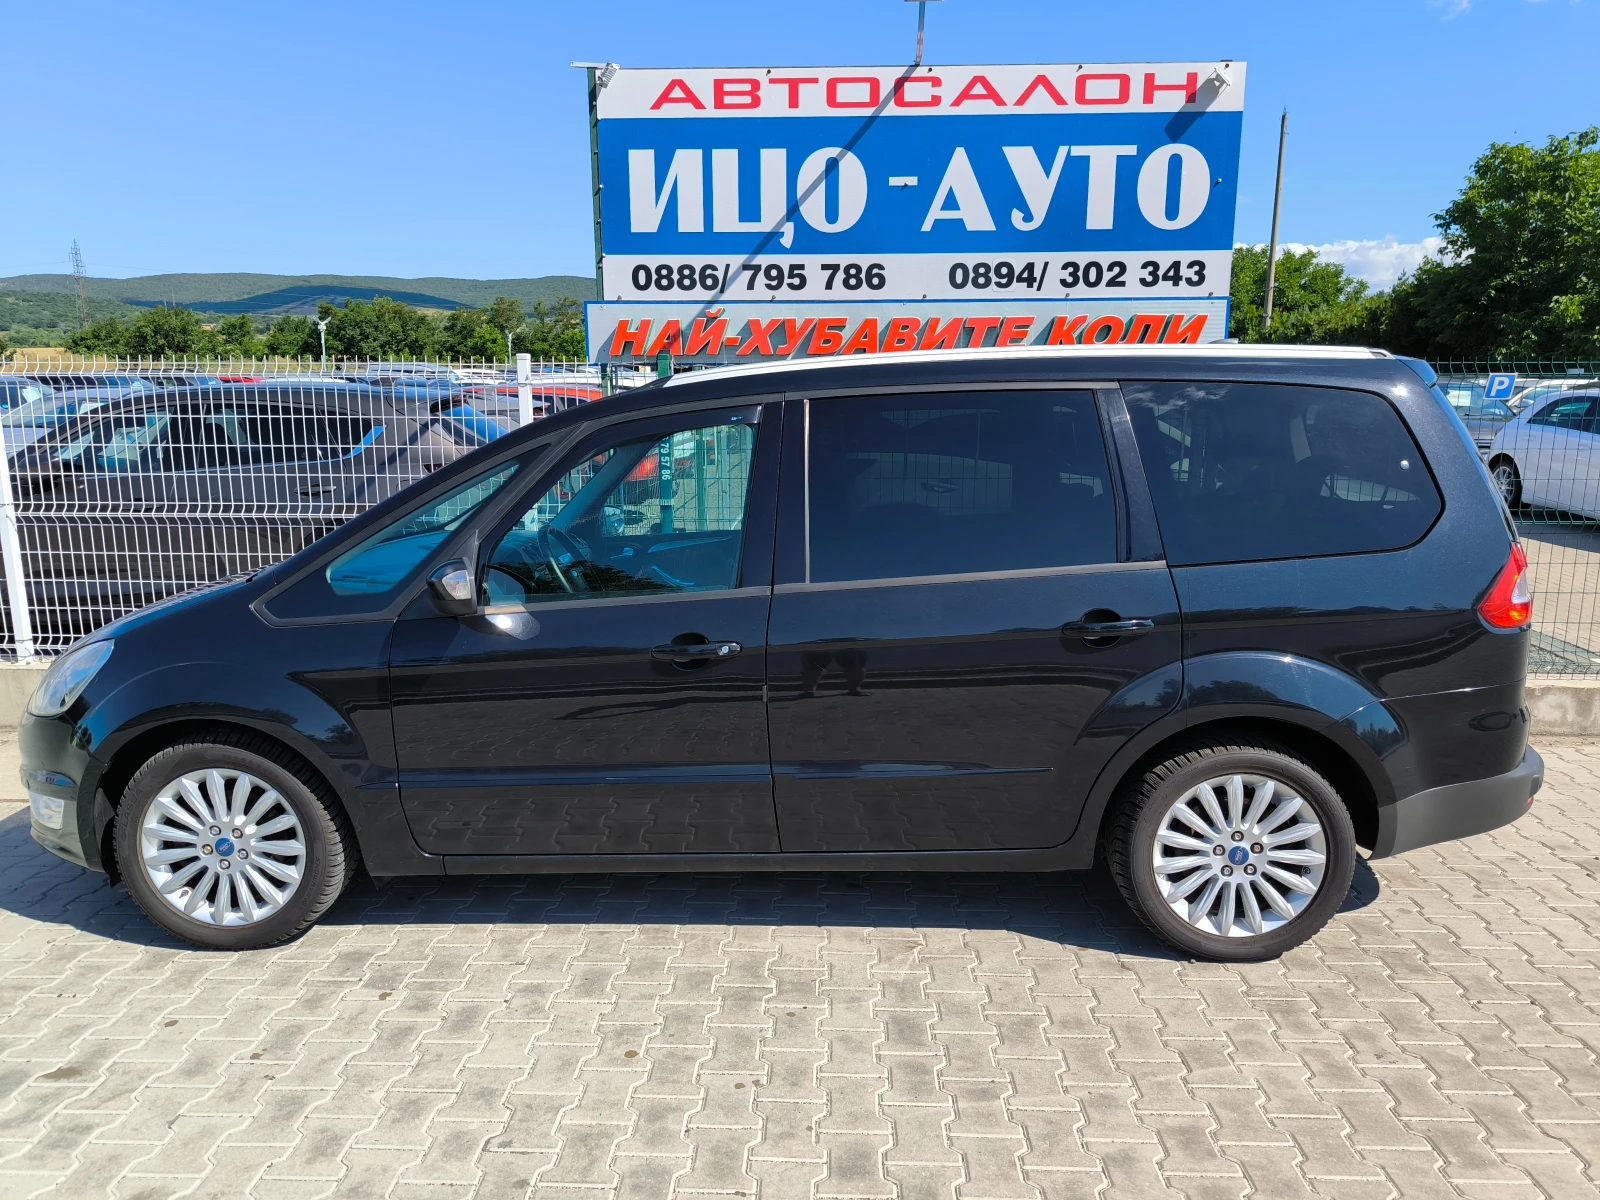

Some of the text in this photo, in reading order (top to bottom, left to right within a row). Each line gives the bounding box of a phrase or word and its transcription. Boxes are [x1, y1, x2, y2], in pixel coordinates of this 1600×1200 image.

[650, 72, 1198, 111] АВТОСАЛОН
[628, 147, 868, 249] ИЦО
[631, 262, 886, 293] 0886/ 795 786
[948, 259, 1206, 292] 0894/ 302 343
[608, 307, 1210, 357] НАЙ-ХУБАВИТЕ КОЛИ
[1490, 377, 1509, 397] P
[660, 442, 670, 454] 79
[660, 456, 670, 467] 57
[661, 469, 671, 481] 86
